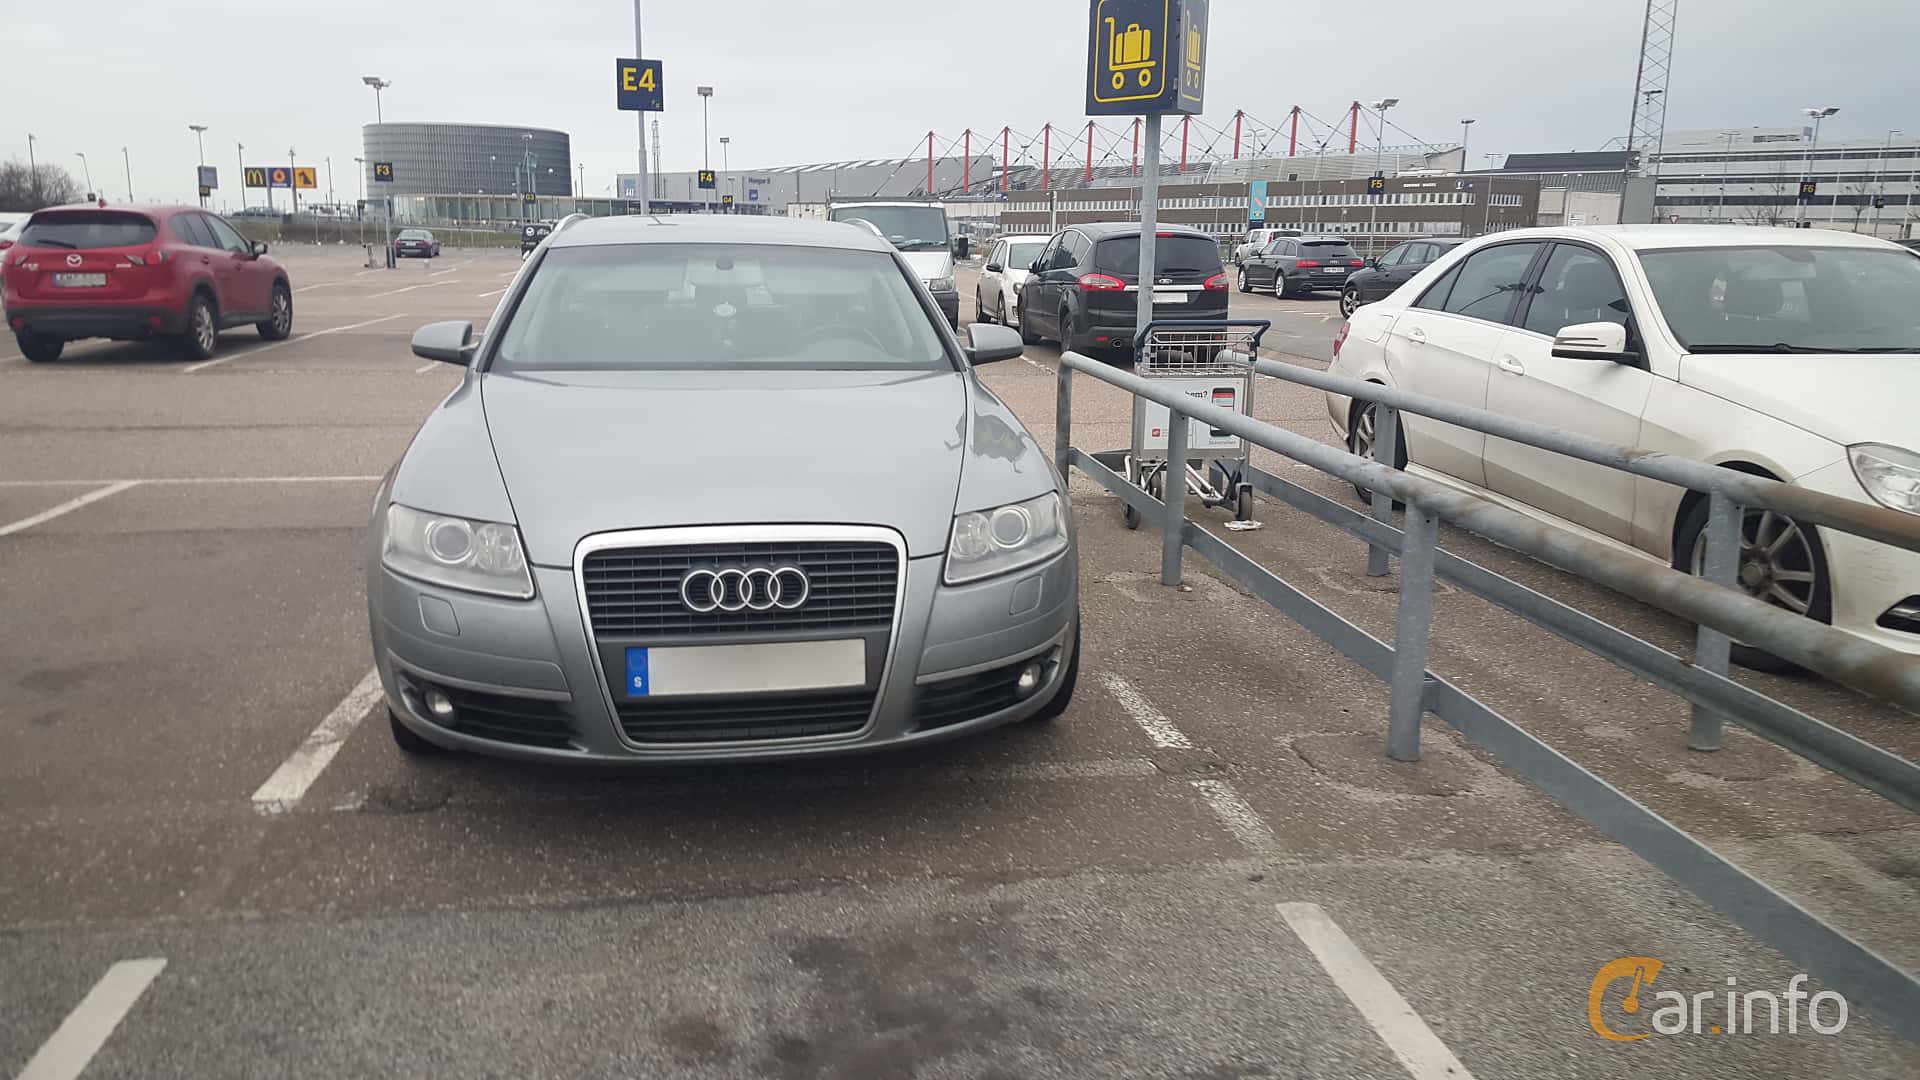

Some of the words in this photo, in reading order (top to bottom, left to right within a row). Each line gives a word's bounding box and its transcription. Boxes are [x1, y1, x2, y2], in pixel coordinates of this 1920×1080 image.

[623, 67, 656, 92] E4
[376, 165, 389, 176] F3
[701, 172, 713, 183] F4
[1370, 179, 1383, 188] F5
[1802, 184, 1814, 193] F6
[634, 676, 642, 688] S
